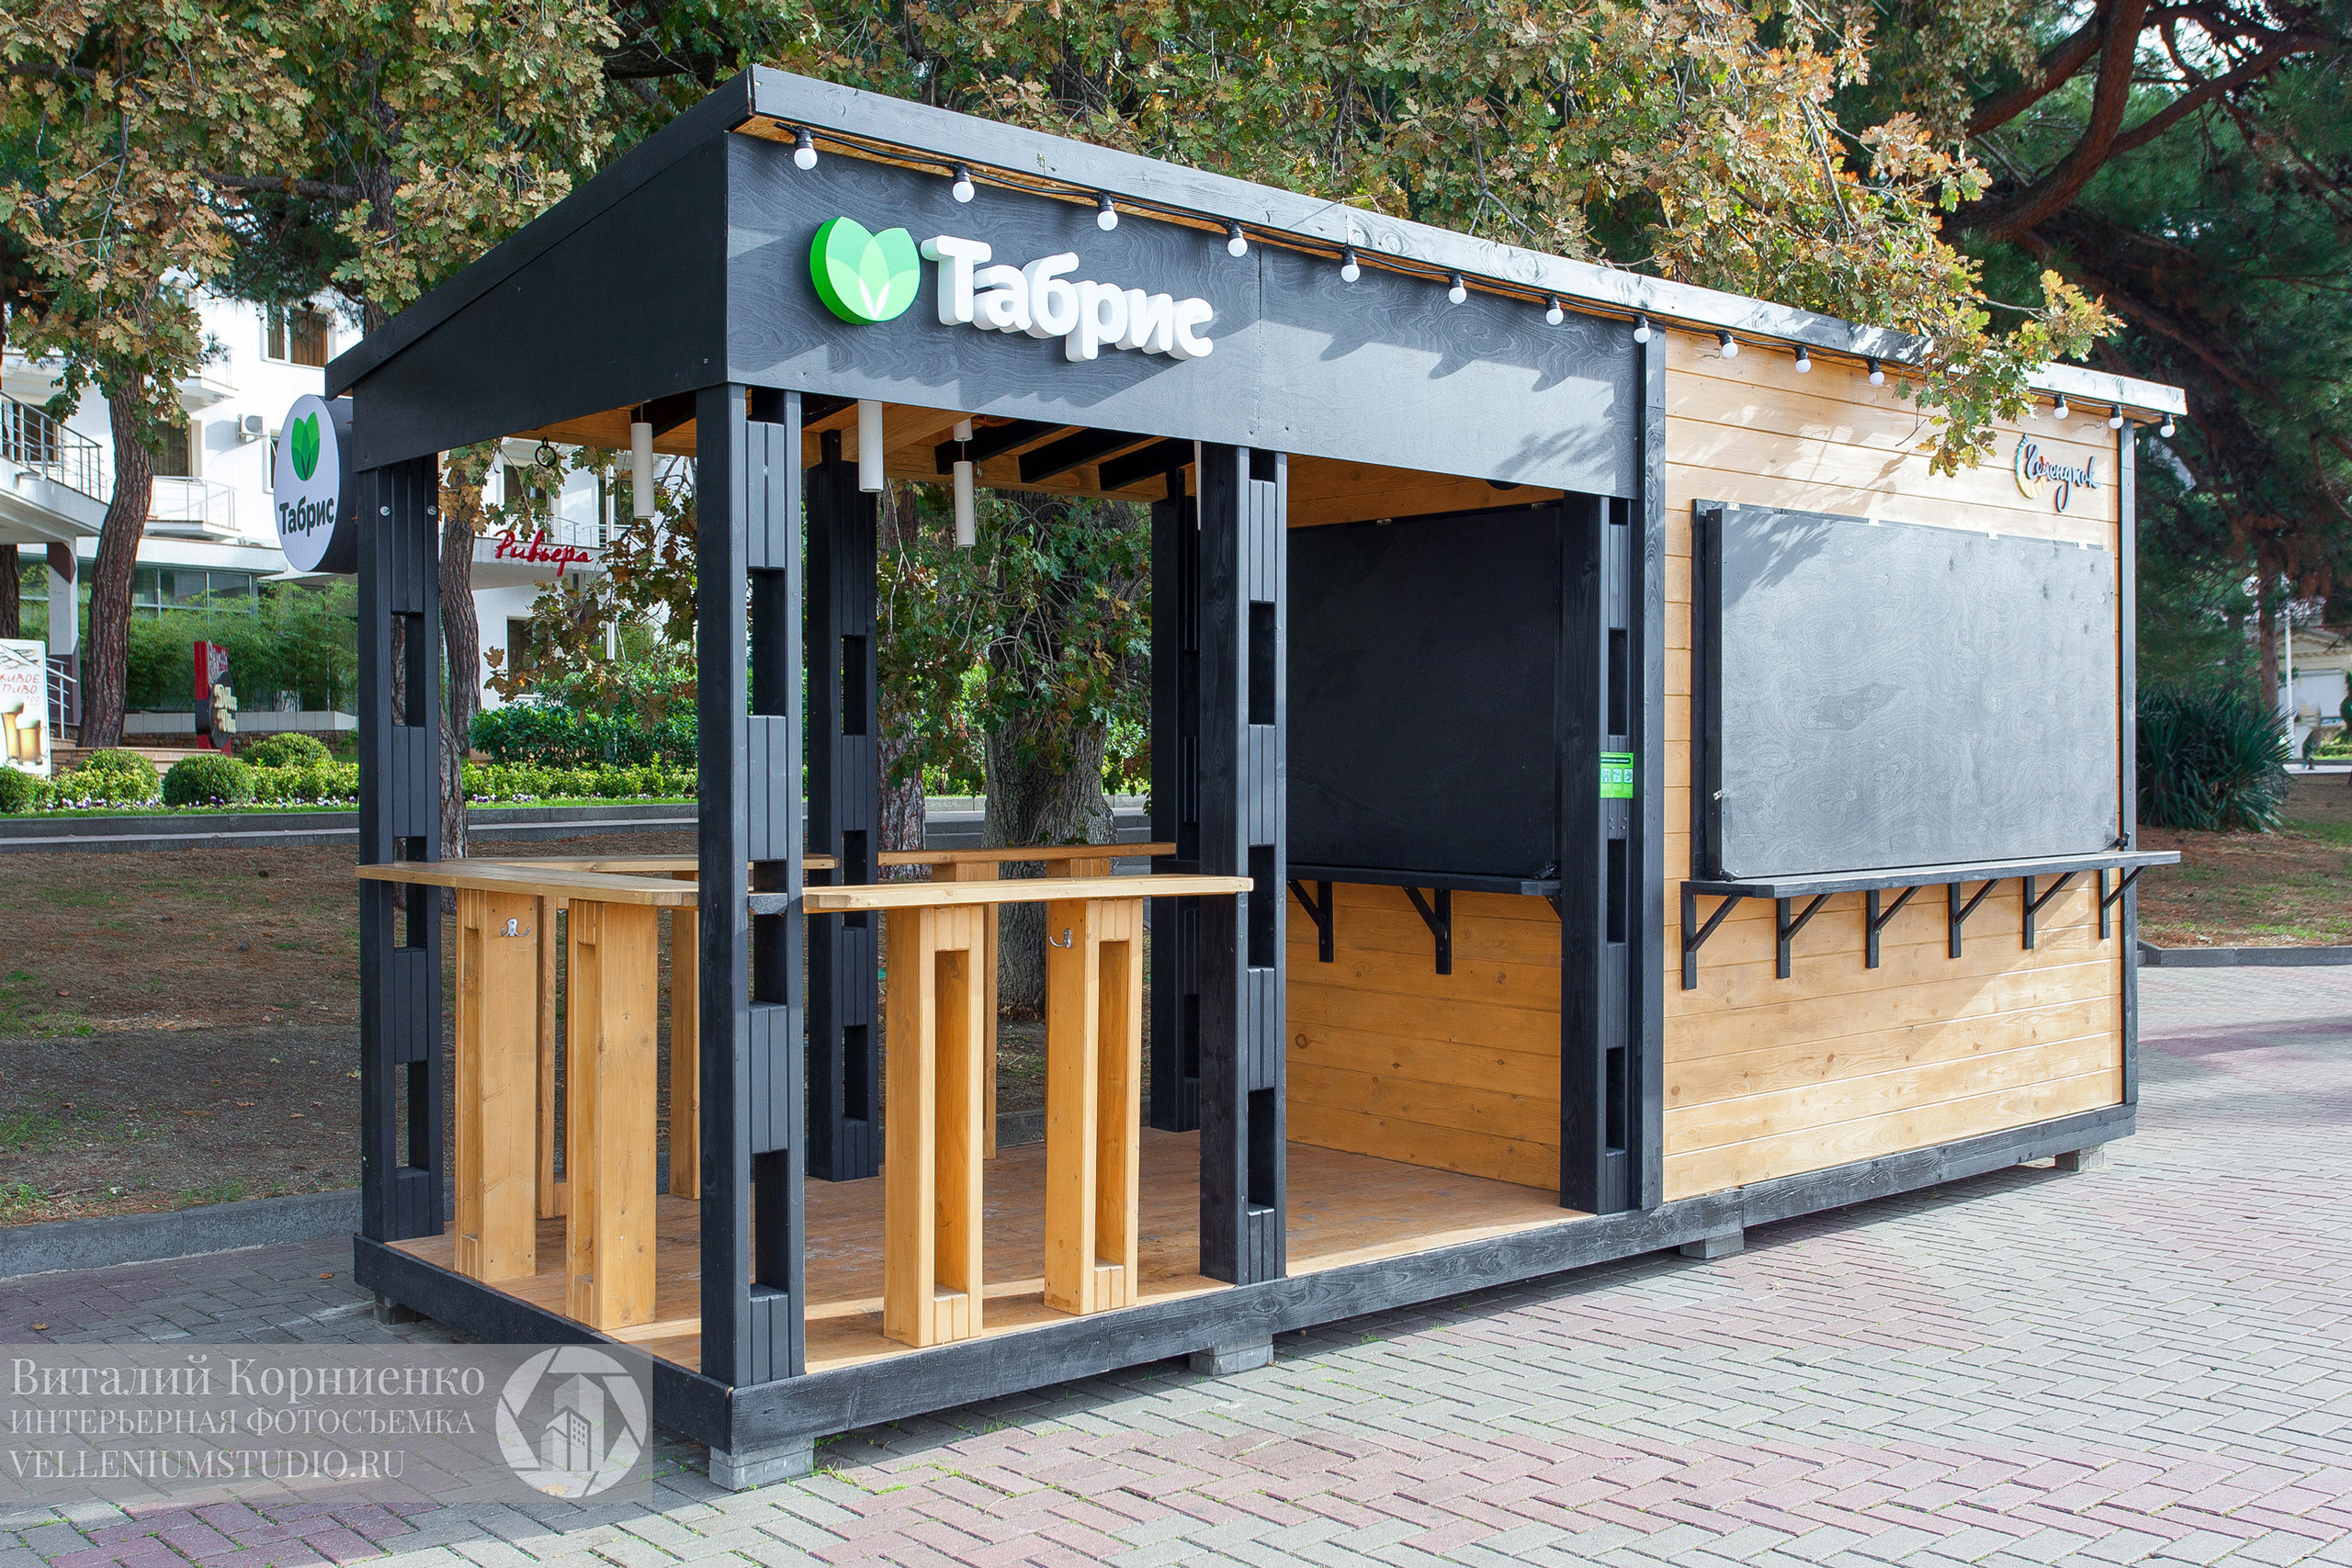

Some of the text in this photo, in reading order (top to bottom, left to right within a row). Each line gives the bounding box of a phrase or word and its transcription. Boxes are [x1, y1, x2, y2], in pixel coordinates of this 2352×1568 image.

[920, 235, 1214, 362] Табрис
[278, 495, 334, 537] Табрис
[493, 527, 594, 577] Ривьера
[2, 684, 39, 694] ПИВО
